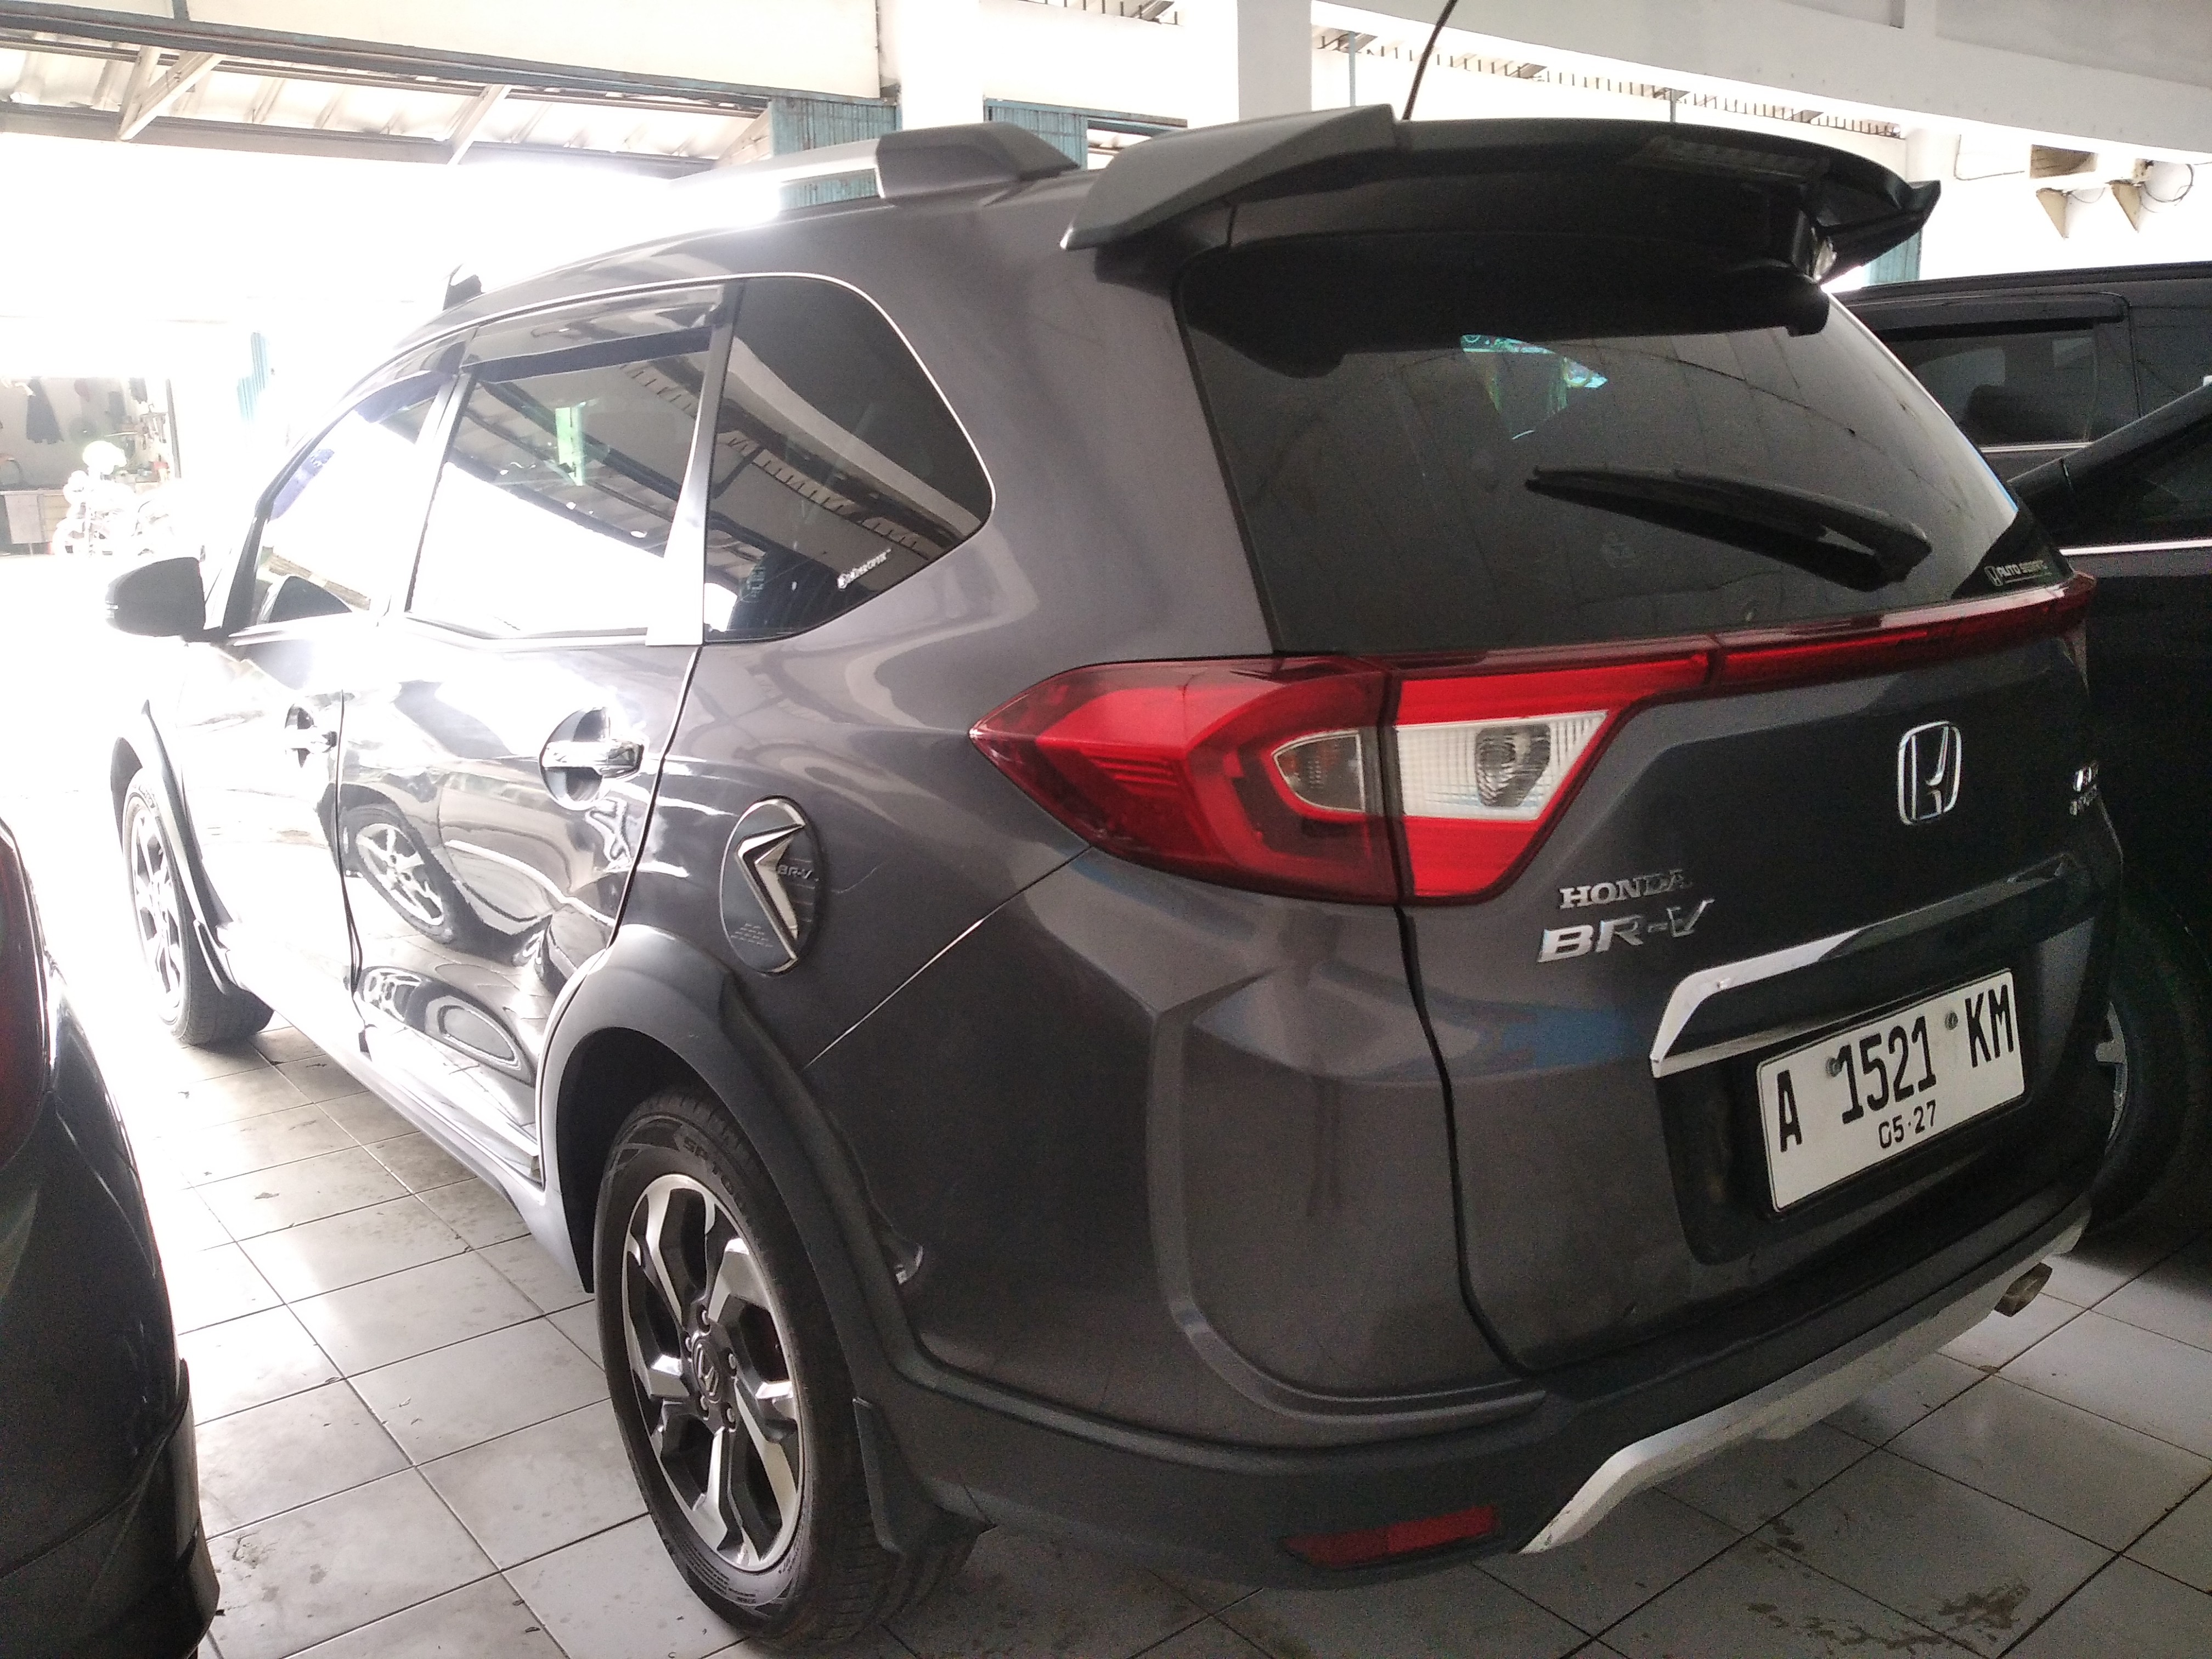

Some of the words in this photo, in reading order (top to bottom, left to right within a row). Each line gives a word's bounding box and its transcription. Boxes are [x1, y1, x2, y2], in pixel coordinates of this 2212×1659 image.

[1559, 868, 1693, 910] HONDA
[1538, 898, 1715, 963] BR-V
[1776, 1069, 1803, 1153] A
[1833, 1015, 1937, 1125] 1521
[1964, 984, 2015, 1068] KM
